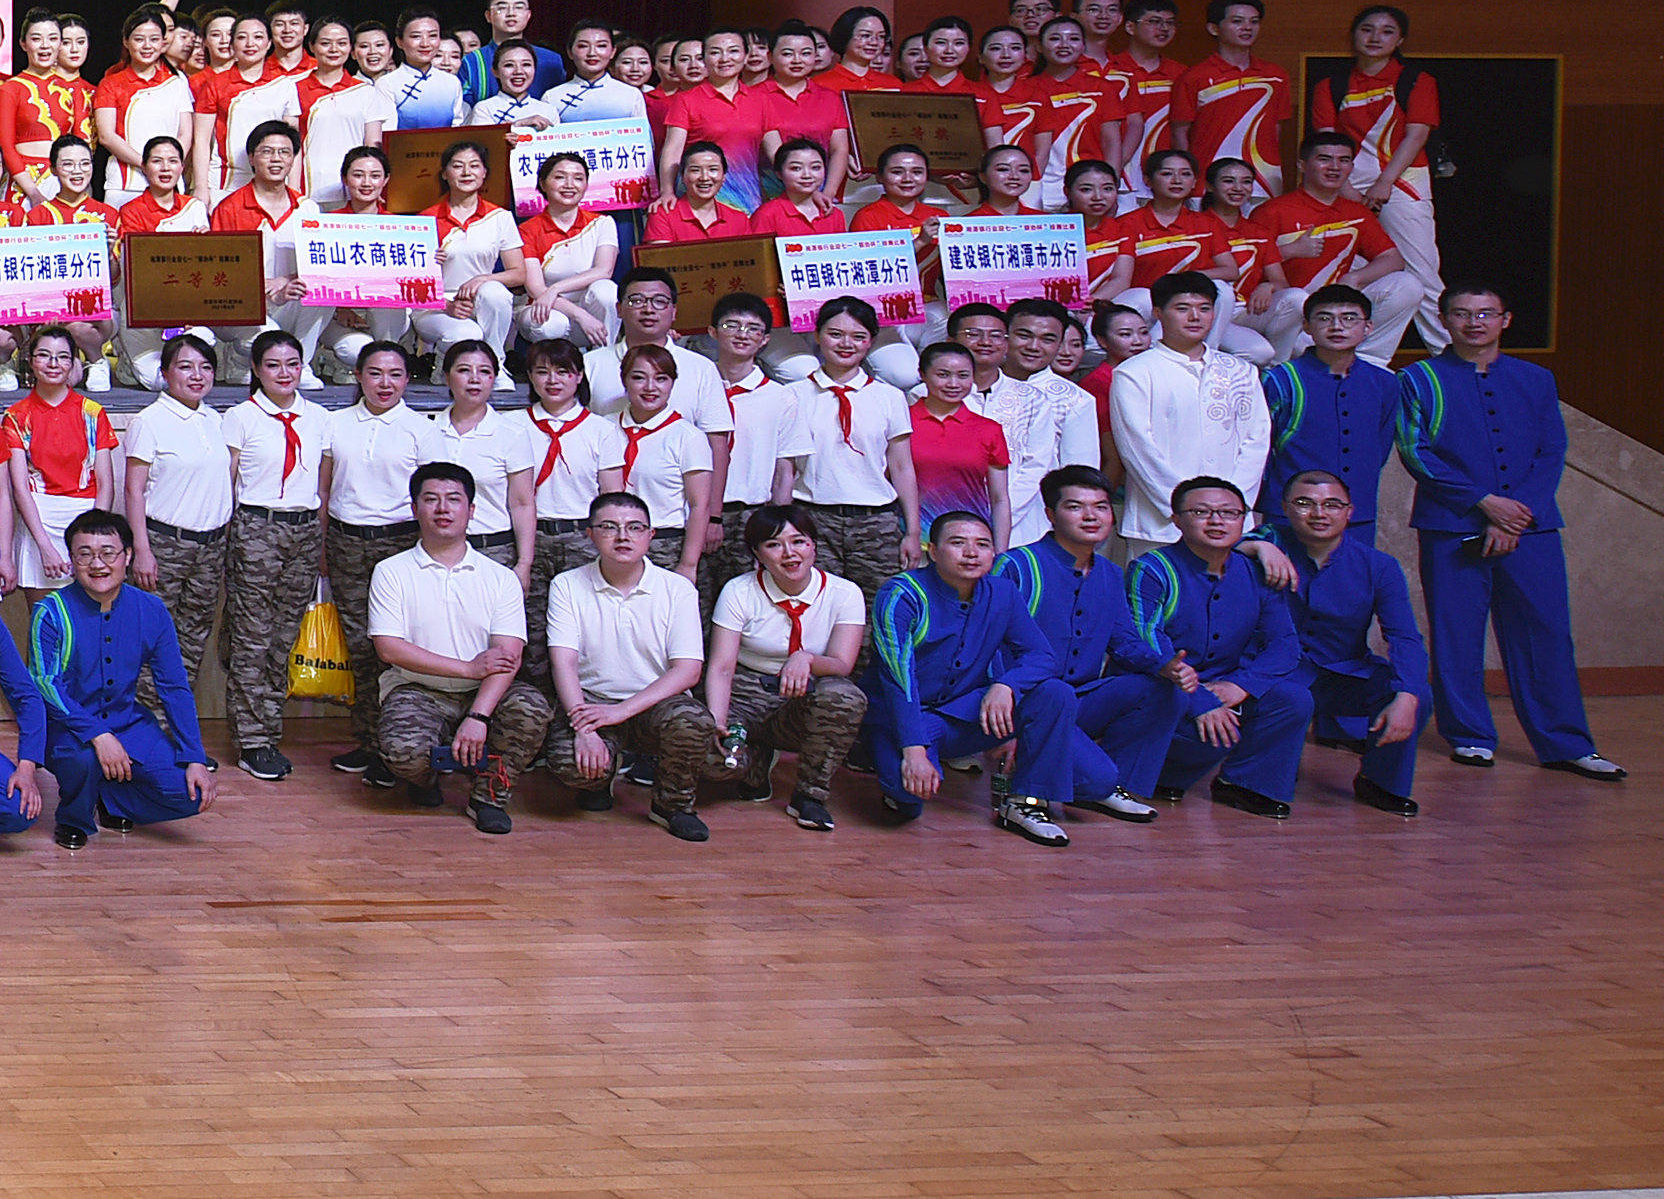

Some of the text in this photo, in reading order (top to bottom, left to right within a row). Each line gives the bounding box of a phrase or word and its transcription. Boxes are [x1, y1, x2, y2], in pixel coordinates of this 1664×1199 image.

[518, 134, 533, 142] 00
[518, 145, 647, 177] 农发潭市分行
[309, 240, 427, 268] 韶山农商银行
[947, 242, 1078, 270] 建设银行湘潭市分行
[163, 271, 229, 289] 二等奖
[677, 276, 745, 295] 三等奖
[790, 258, 909, 291] 中国银行湘潭分行
